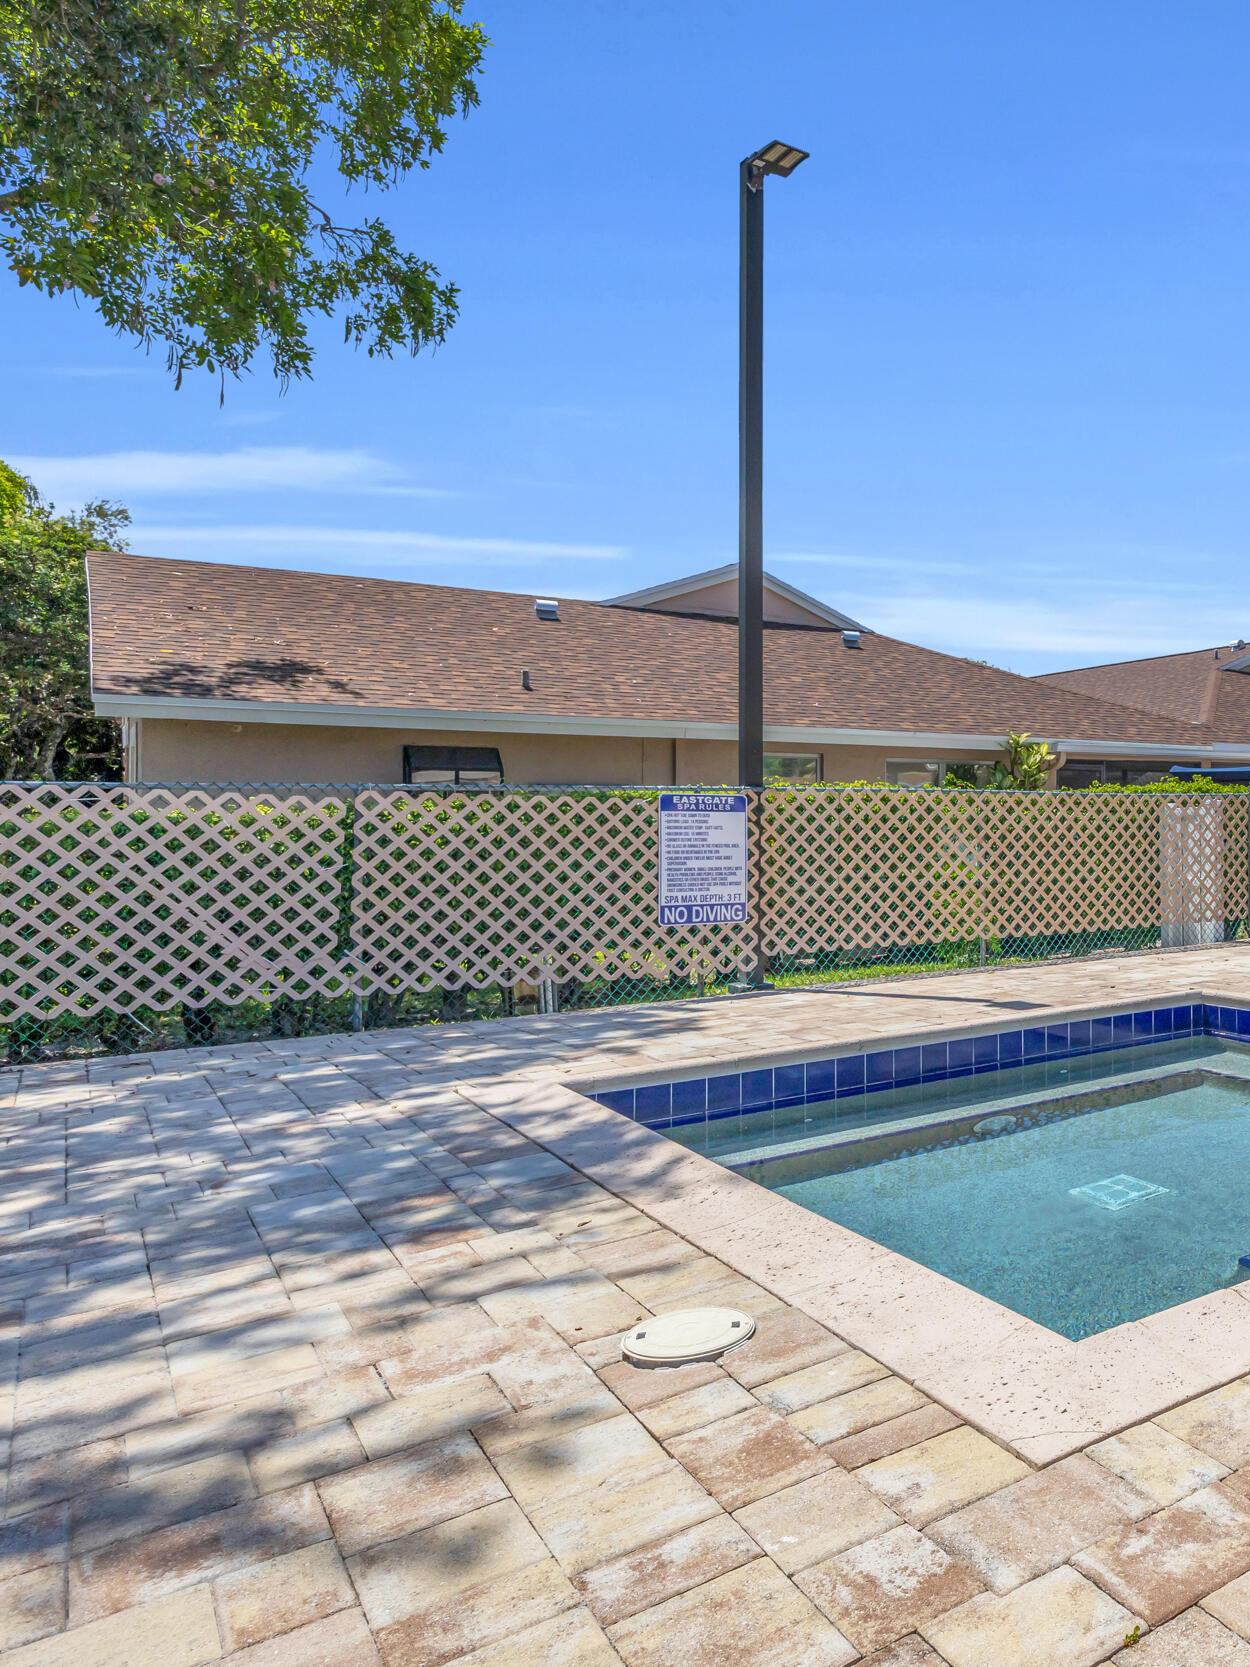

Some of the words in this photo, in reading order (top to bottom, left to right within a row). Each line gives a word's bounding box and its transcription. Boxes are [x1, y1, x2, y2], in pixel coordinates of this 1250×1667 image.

[672, 796, 735, 804] EASTGATE
[664, 895, 679, 904] SPA
[681, 895, 698, 903] MAX
[700, 894, 725, 903] DEPTH:
[727, 894, 732, 902] 3
[733, 893, 742, 901] FT
[664, 906, 688, 924] NO
[692, 904, 743, 922] DIVING
